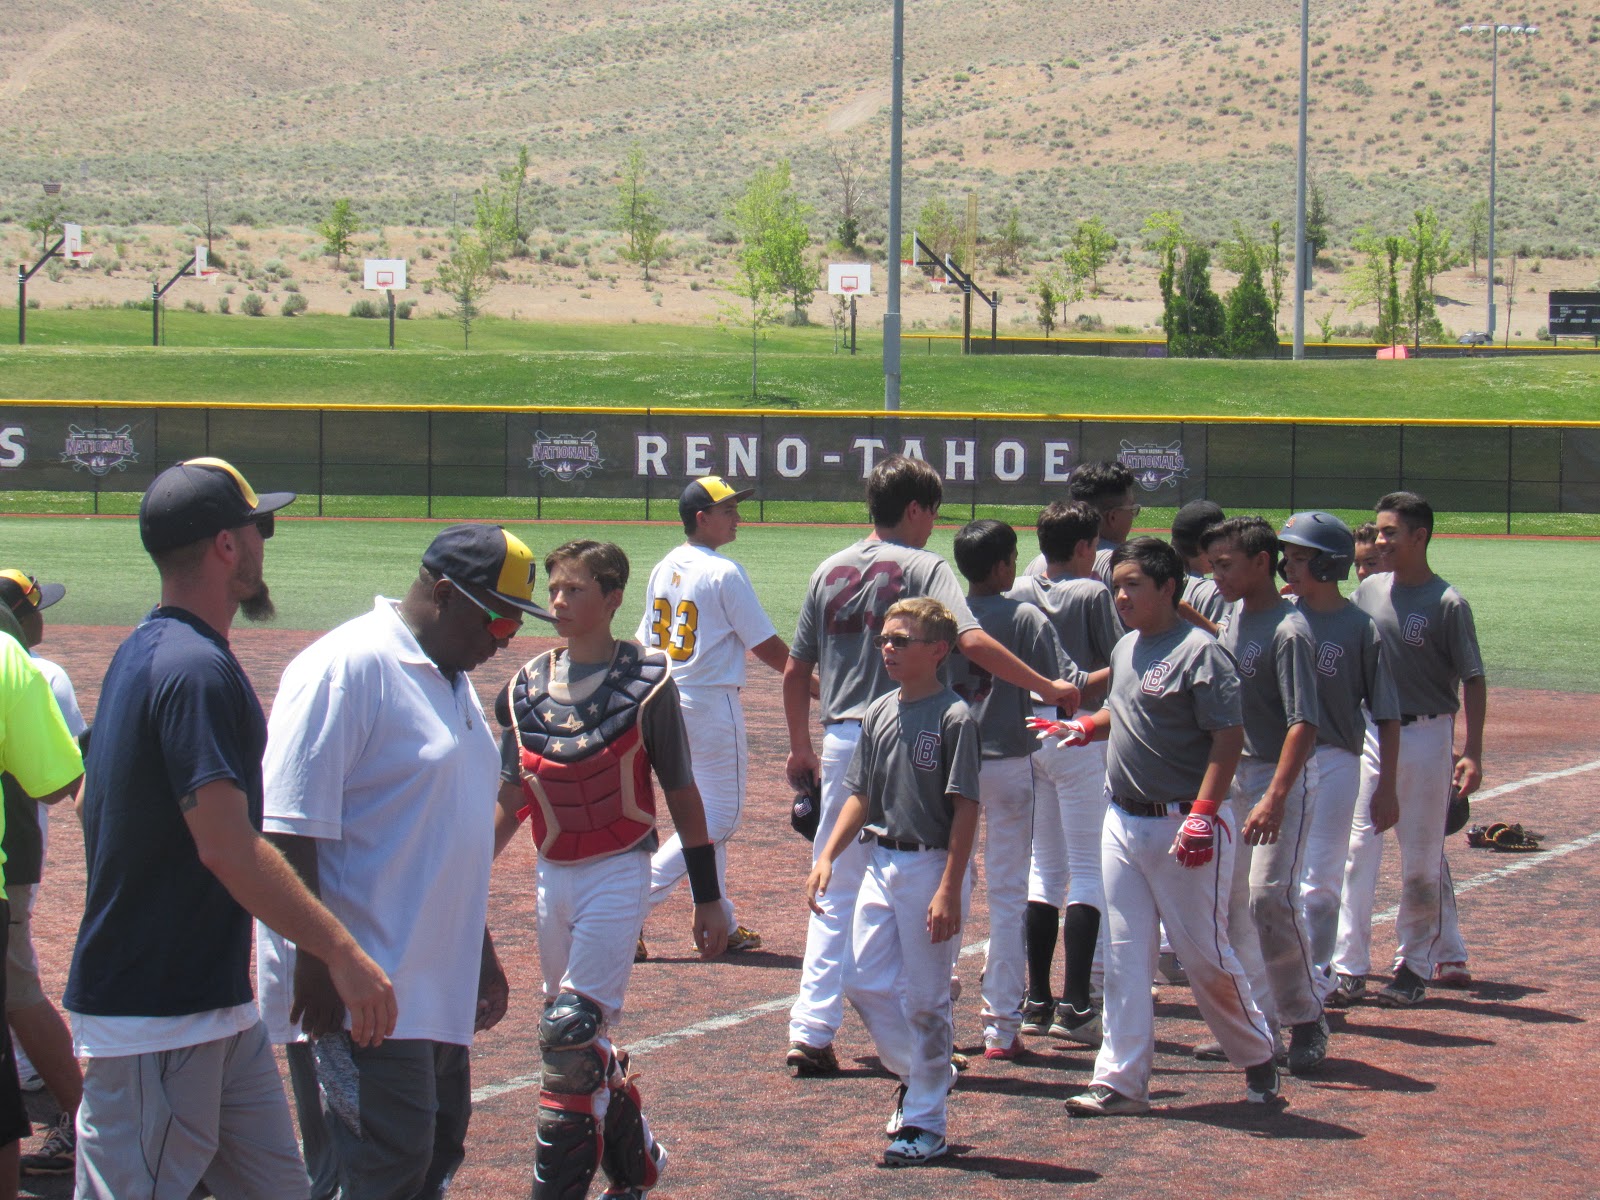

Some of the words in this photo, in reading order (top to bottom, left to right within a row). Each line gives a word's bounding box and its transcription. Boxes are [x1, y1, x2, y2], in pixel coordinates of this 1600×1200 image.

[0, 427, 25, 468] S
[66, 439, 134, 456] NATIONALS
[533, 444, 599, 462] NATIONALS
[651, 597, 699, 662] 33
